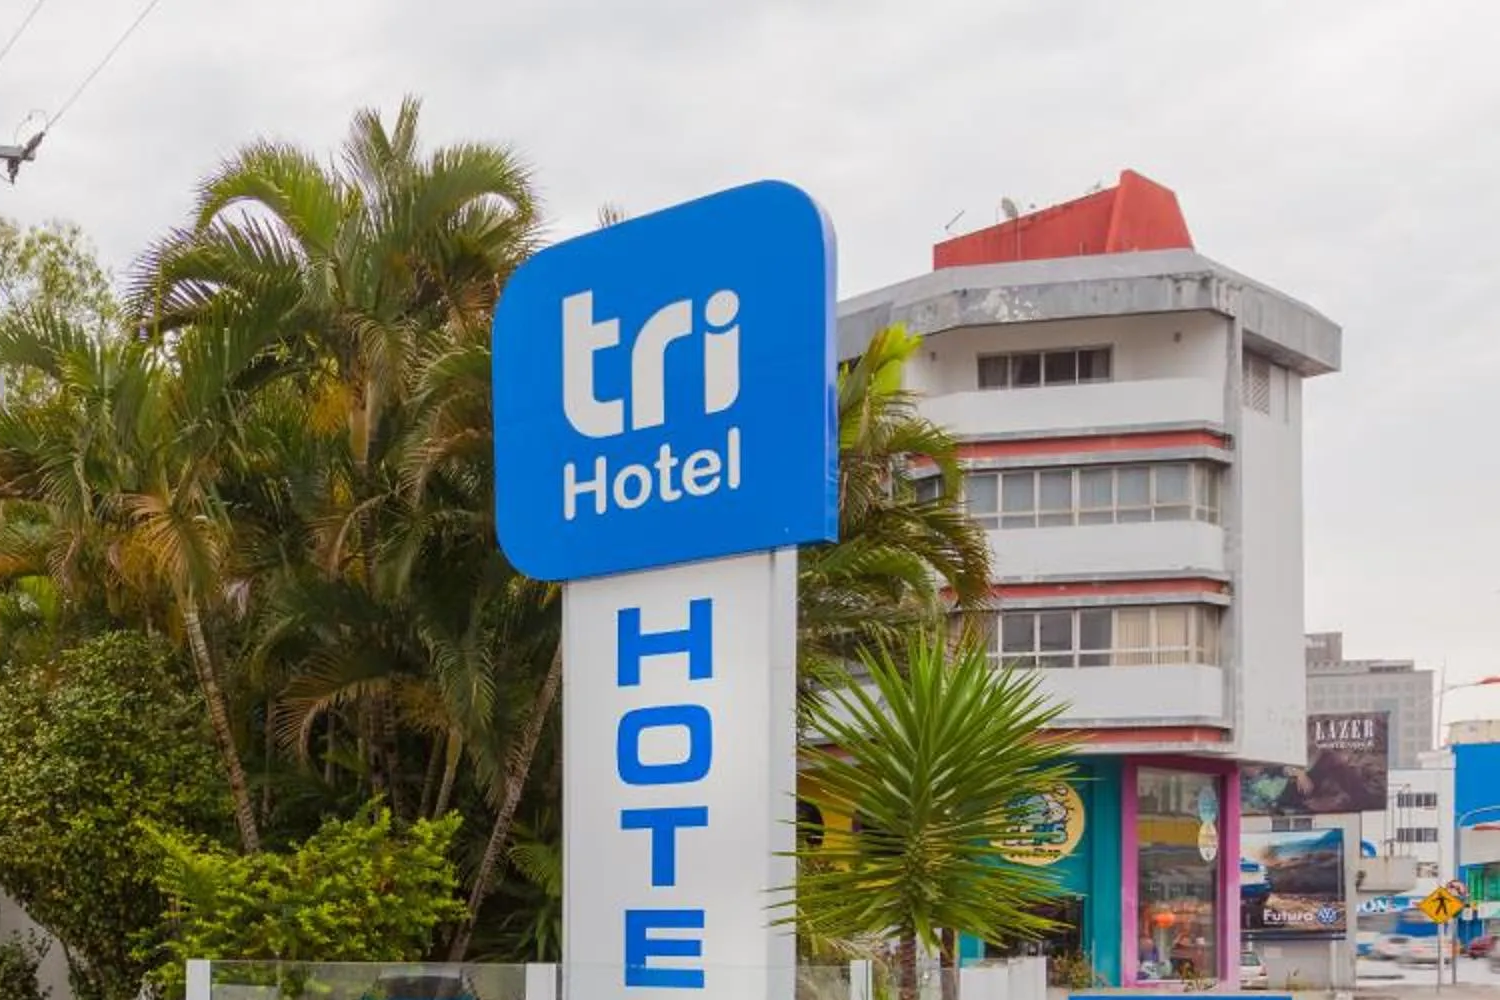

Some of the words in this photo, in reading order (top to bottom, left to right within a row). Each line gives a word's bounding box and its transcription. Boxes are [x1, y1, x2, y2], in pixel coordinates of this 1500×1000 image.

[562, 289, 741, 439] tri
[563, 427, 741, 521] Hotel
[1315, 719, 1373, 741] LAZER
[1263, 907, 1313, 921] Futura
